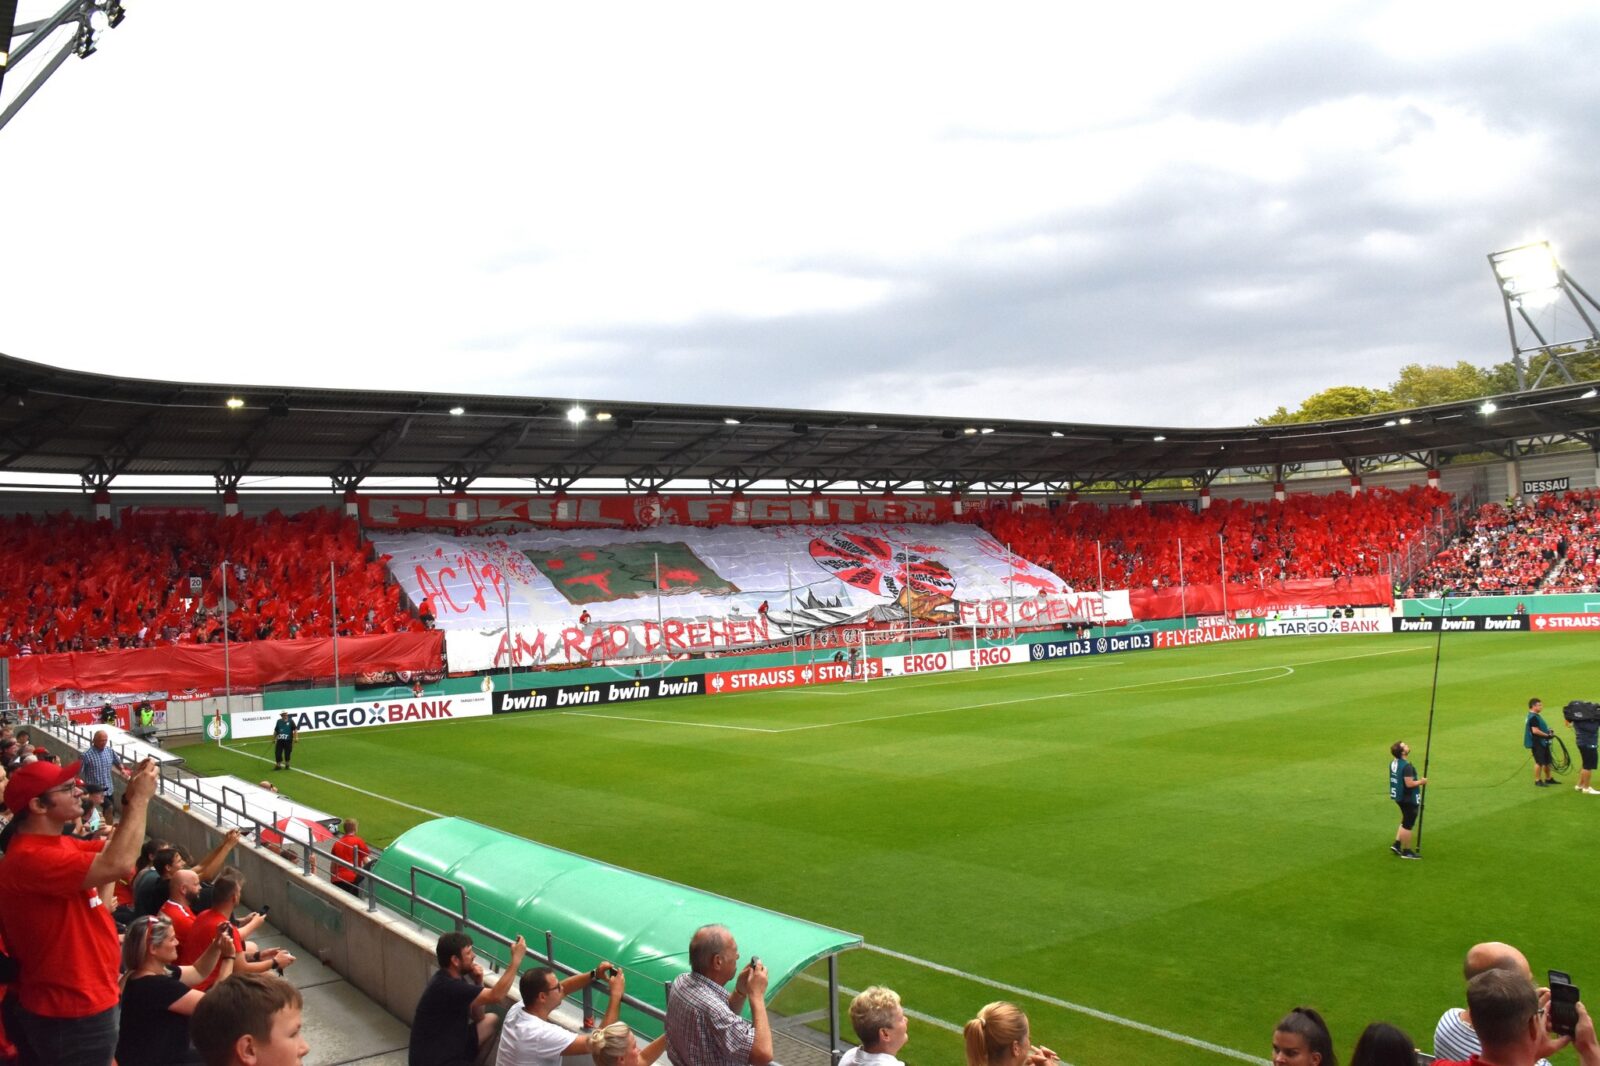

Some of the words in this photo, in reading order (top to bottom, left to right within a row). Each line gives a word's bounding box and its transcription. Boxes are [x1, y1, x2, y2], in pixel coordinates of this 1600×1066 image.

[1525, 479, 1567, 492] DESSAU
[191, 579, 201, 587] 20
[1018, 595, 1107, 624] CHEMIE
[1400, 617, 1433, 631] bwin
[1441, 616, 1476, 630] bwin
[1484, 615, 1521, 629] bwin
[493, 627, 547, 667] AM
[561, 623, 629, 664] RAD
[643, 615, 769, 657] DREHEN
[1111, 639, 1130, 651] Der
[1131, 635, 1151, 648] ID.3
[1166, 624, 1247, 647] FLYERALARM
[970, 646, 1011, 667] ERGO
[1049, 645, 1067, 658] Der
[1069, 641, 1091, 655] ID.3
[903, 653, 947, 673] ERGO
[658, 677, 698, 696] bwin
[731, 669, 796, 688] STRAUSS
[501, 690, 547, 711] bwin
[556, 685, 600, 706] bwin
[608, 681, 650, 701] bwin
